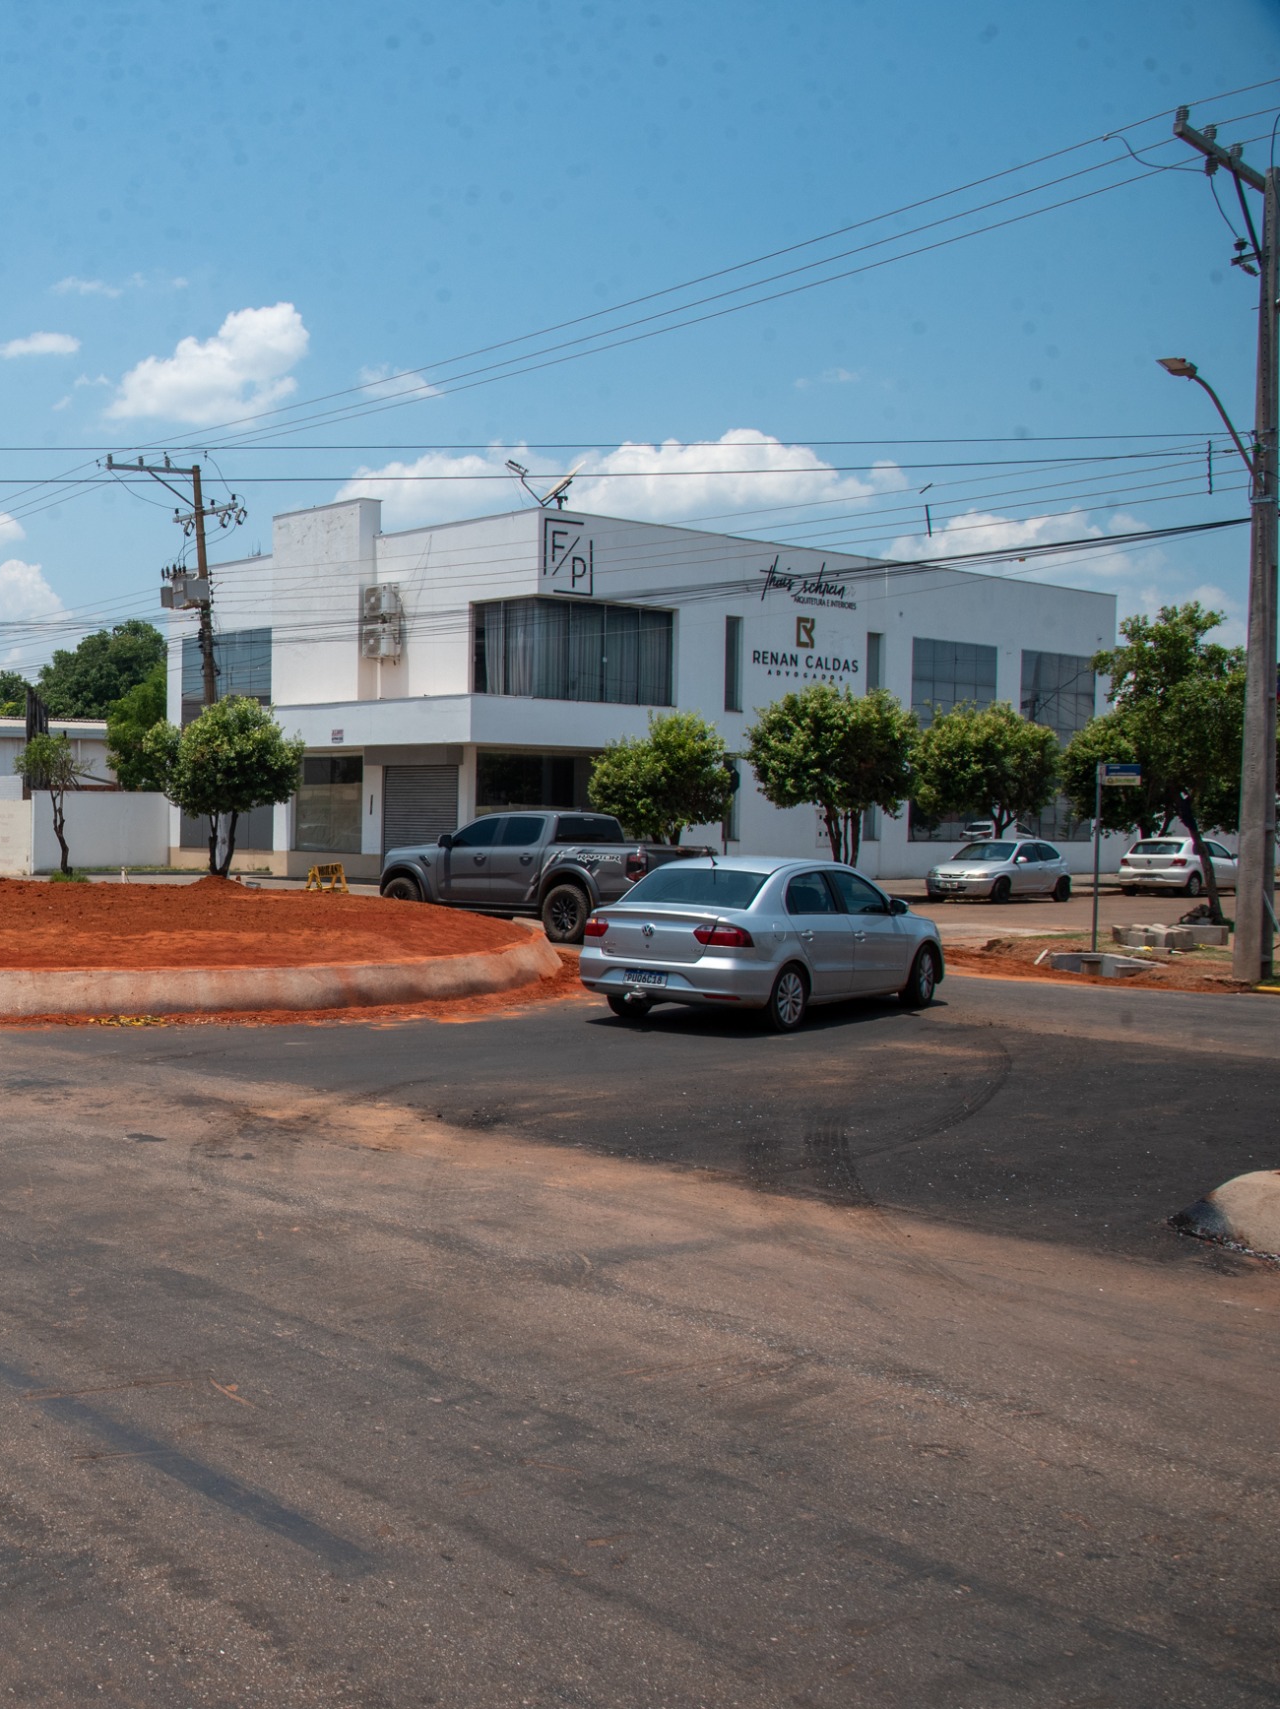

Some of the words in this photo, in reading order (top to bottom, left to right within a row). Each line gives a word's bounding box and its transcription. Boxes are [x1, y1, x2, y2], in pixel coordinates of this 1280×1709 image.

[794, 596, 826, 607] ARQUITETURA
[830, 600, 857, 610] INTERIORES
[752, 650, 798, 667] RENAN
[805, 655, 859, 673] CALDAS
[767, 669, 843, 682] ADVOGADOS
[577, 853, 622, 864] RAPTOR
